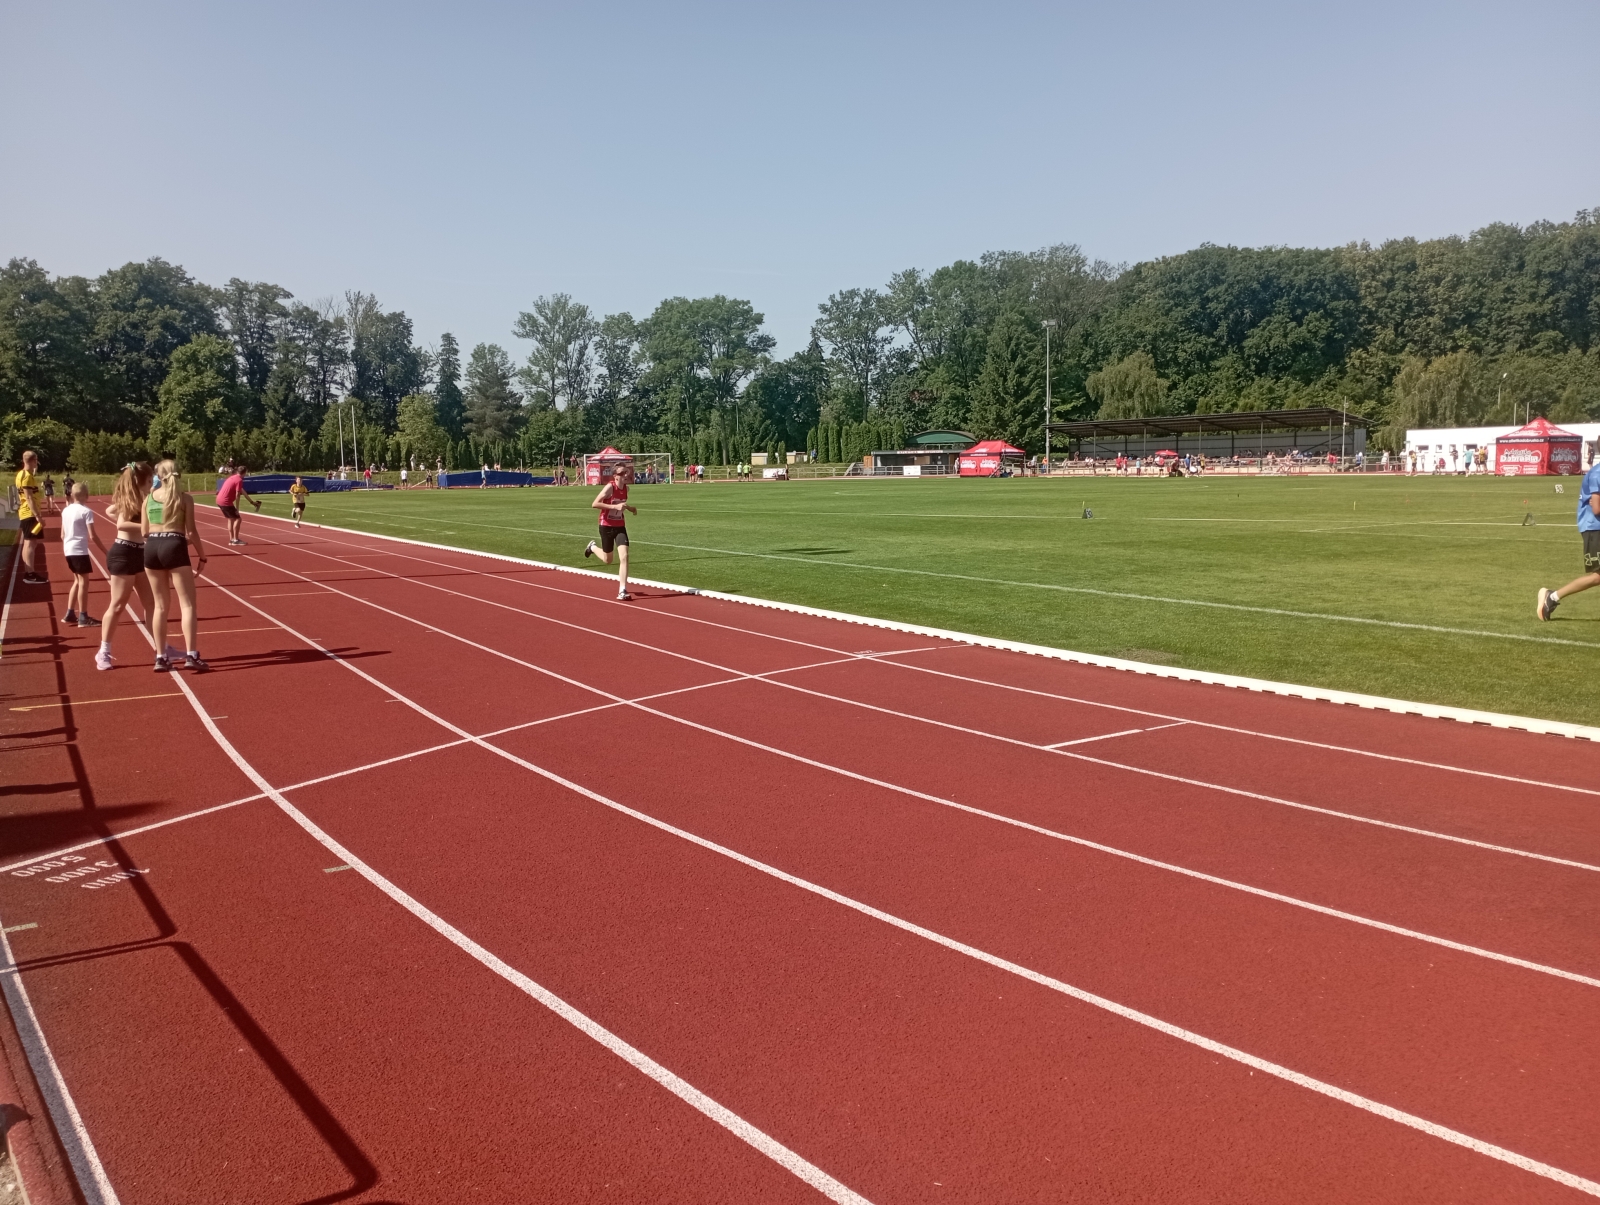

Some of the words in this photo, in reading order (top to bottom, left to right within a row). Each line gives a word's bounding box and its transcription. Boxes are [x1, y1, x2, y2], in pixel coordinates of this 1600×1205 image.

[10, 855, 87, 878] 5000
[44, 860, 119, 883] 3000
[80, 868, 151, 889] 1000
